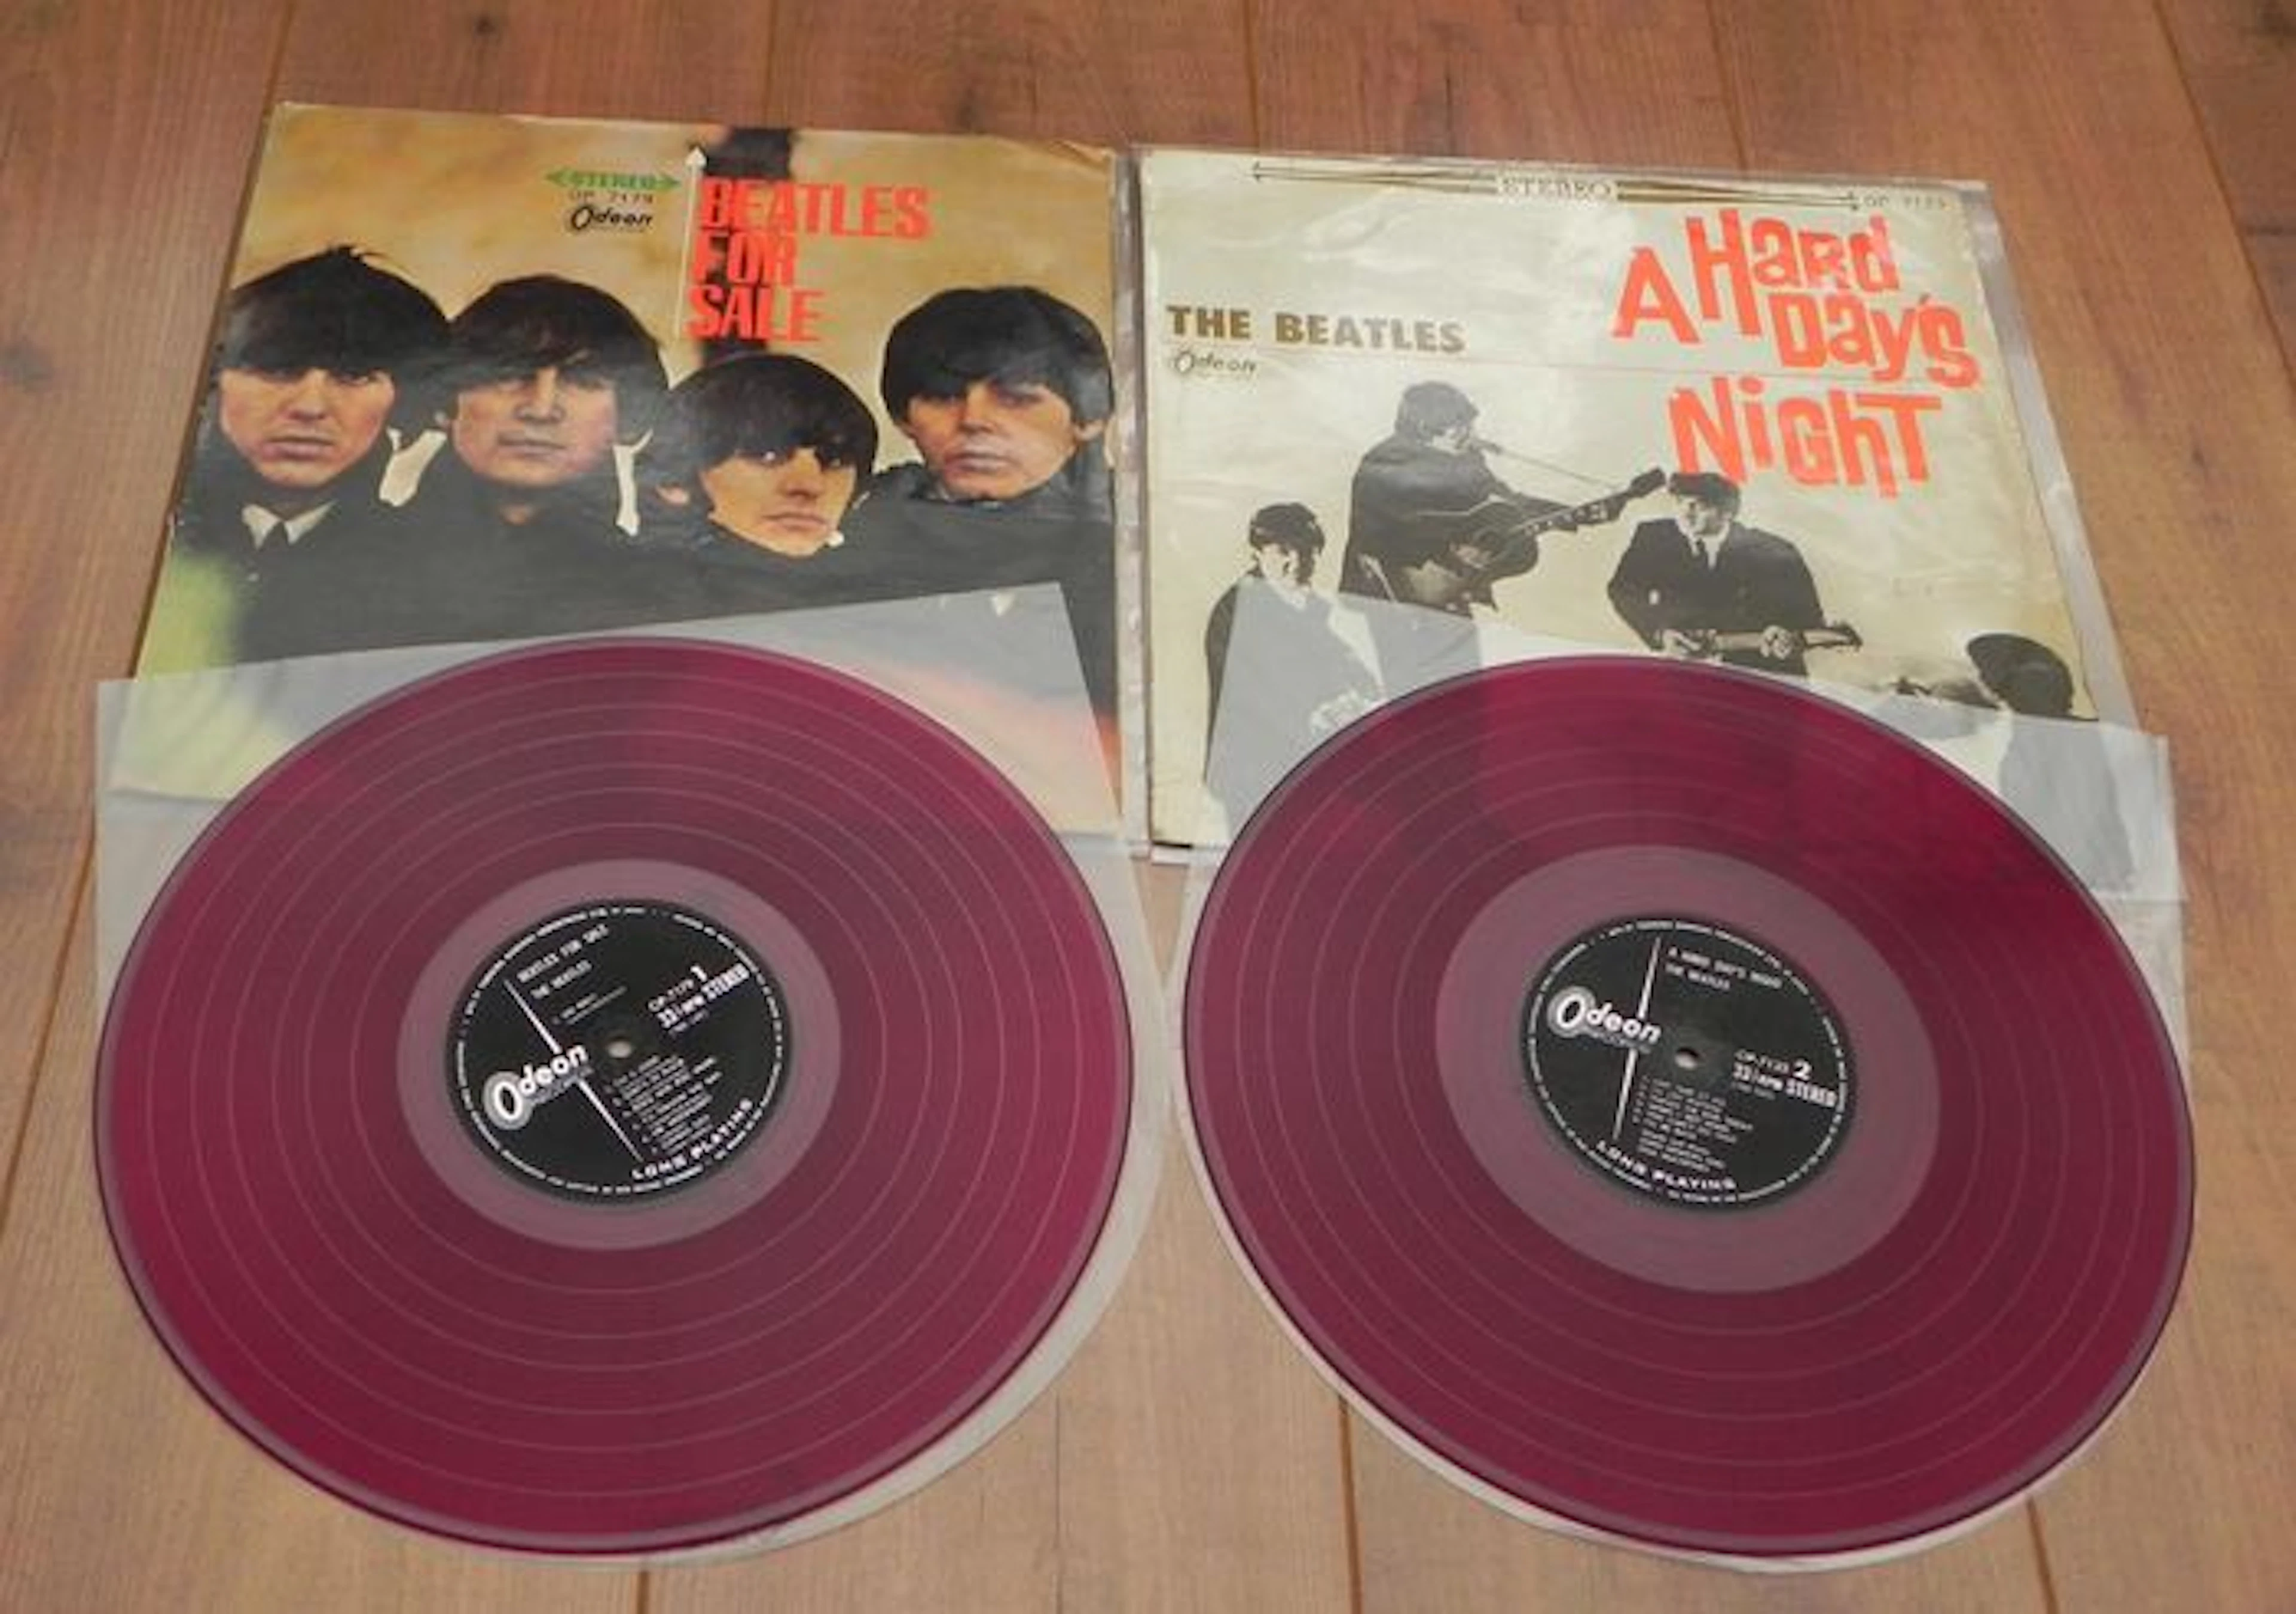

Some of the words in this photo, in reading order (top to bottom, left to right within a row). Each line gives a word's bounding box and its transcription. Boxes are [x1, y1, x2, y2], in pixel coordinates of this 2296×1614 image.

[701, 178, 933, 239] BEATLES
[1502, 176, 1613, 200] STEREO
[571, 205, 653, 230] Odeon
[692, 231, 798, 286] FOR
[686, 283, 825, 342] SALE
[1611, 246, 1700, 344] A
[1166, 305, 1251, 340] THE
[1275, 312, 1465, 353] BEATLES
[1174, 344, 1256, 375] Odeon
[690, 964, 708, 983] 1
[1552, 991, 1662, 1043] Odeon
[487, 1044, 589, 1123] Odeon
[1785, 1078, 1837, 1107] STEREO
[1793, 1058, 1813, 1081] 2
[1596, 1139, 1647, 1176] LONG
[1650, 1169, 1736, 1190] PLAYING
